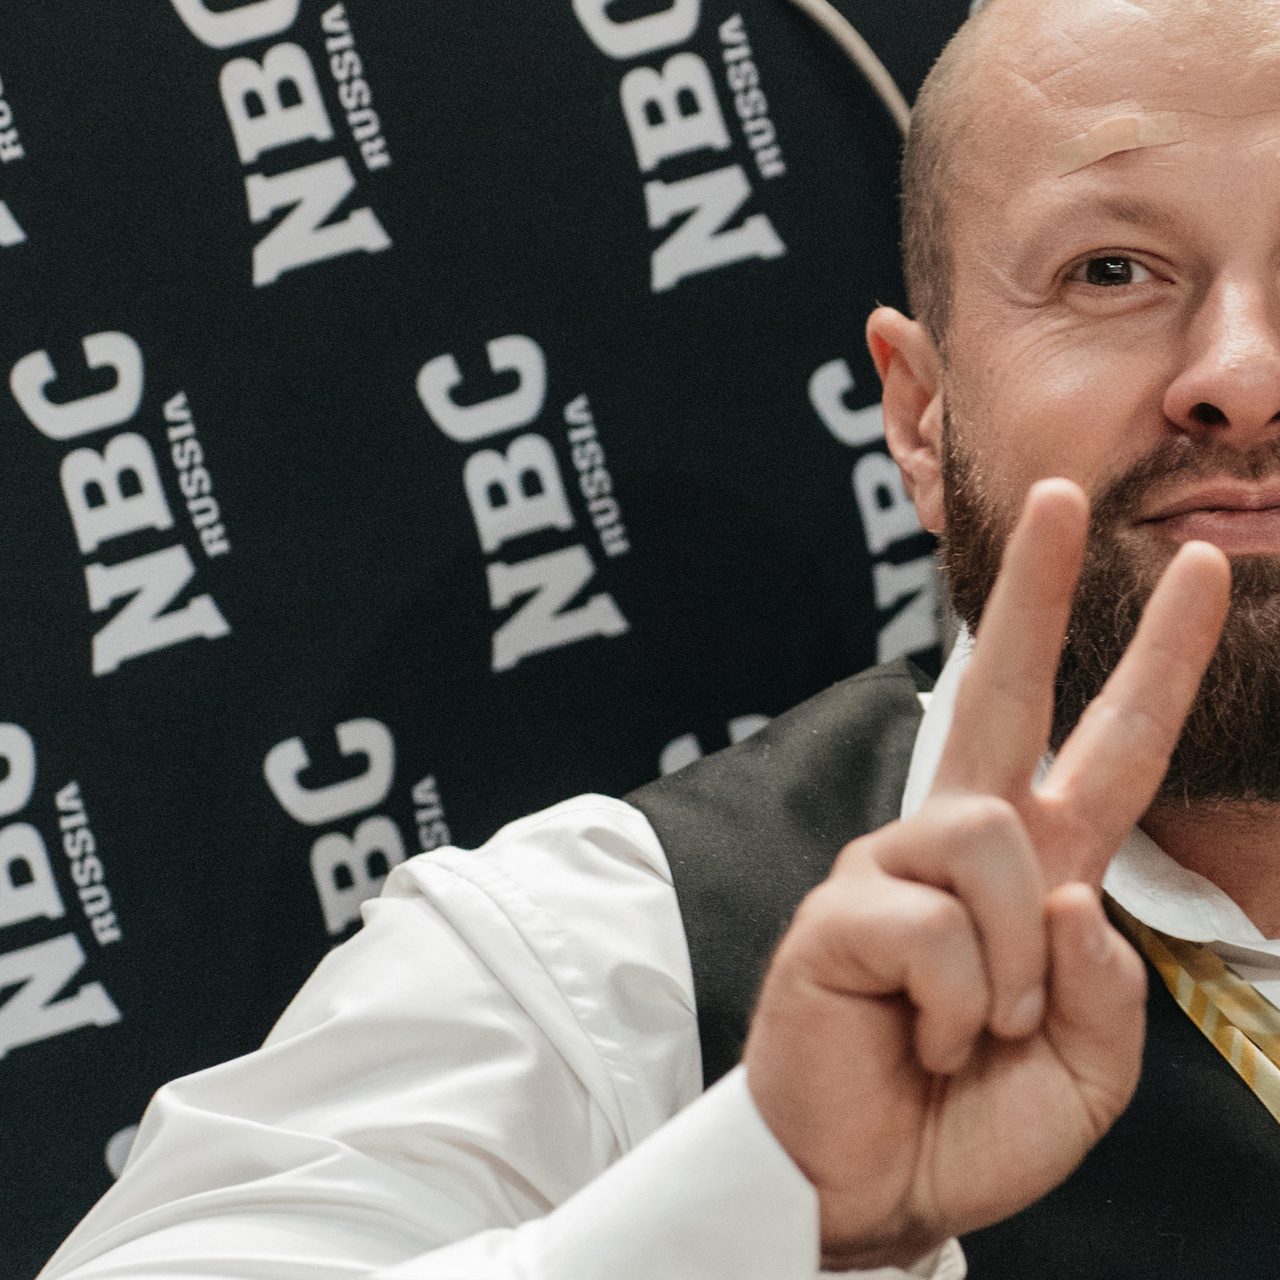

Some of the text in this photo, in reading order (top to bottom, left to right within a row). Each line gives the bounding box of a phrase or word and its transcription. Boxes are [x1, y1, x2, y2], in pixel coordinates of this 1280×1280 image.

[320, 2, 391, 171] RUSSIA
[718, 14, 785, 179] RUSSIA
[9, 331, 231, 677] NBC
[162, 391, 230, 558] RUSSIA
[415, 334, 629, 672] NBC
[563, 395, 629, 556] RUSSIA
[55, 780, 122, 946] RUSSIA
